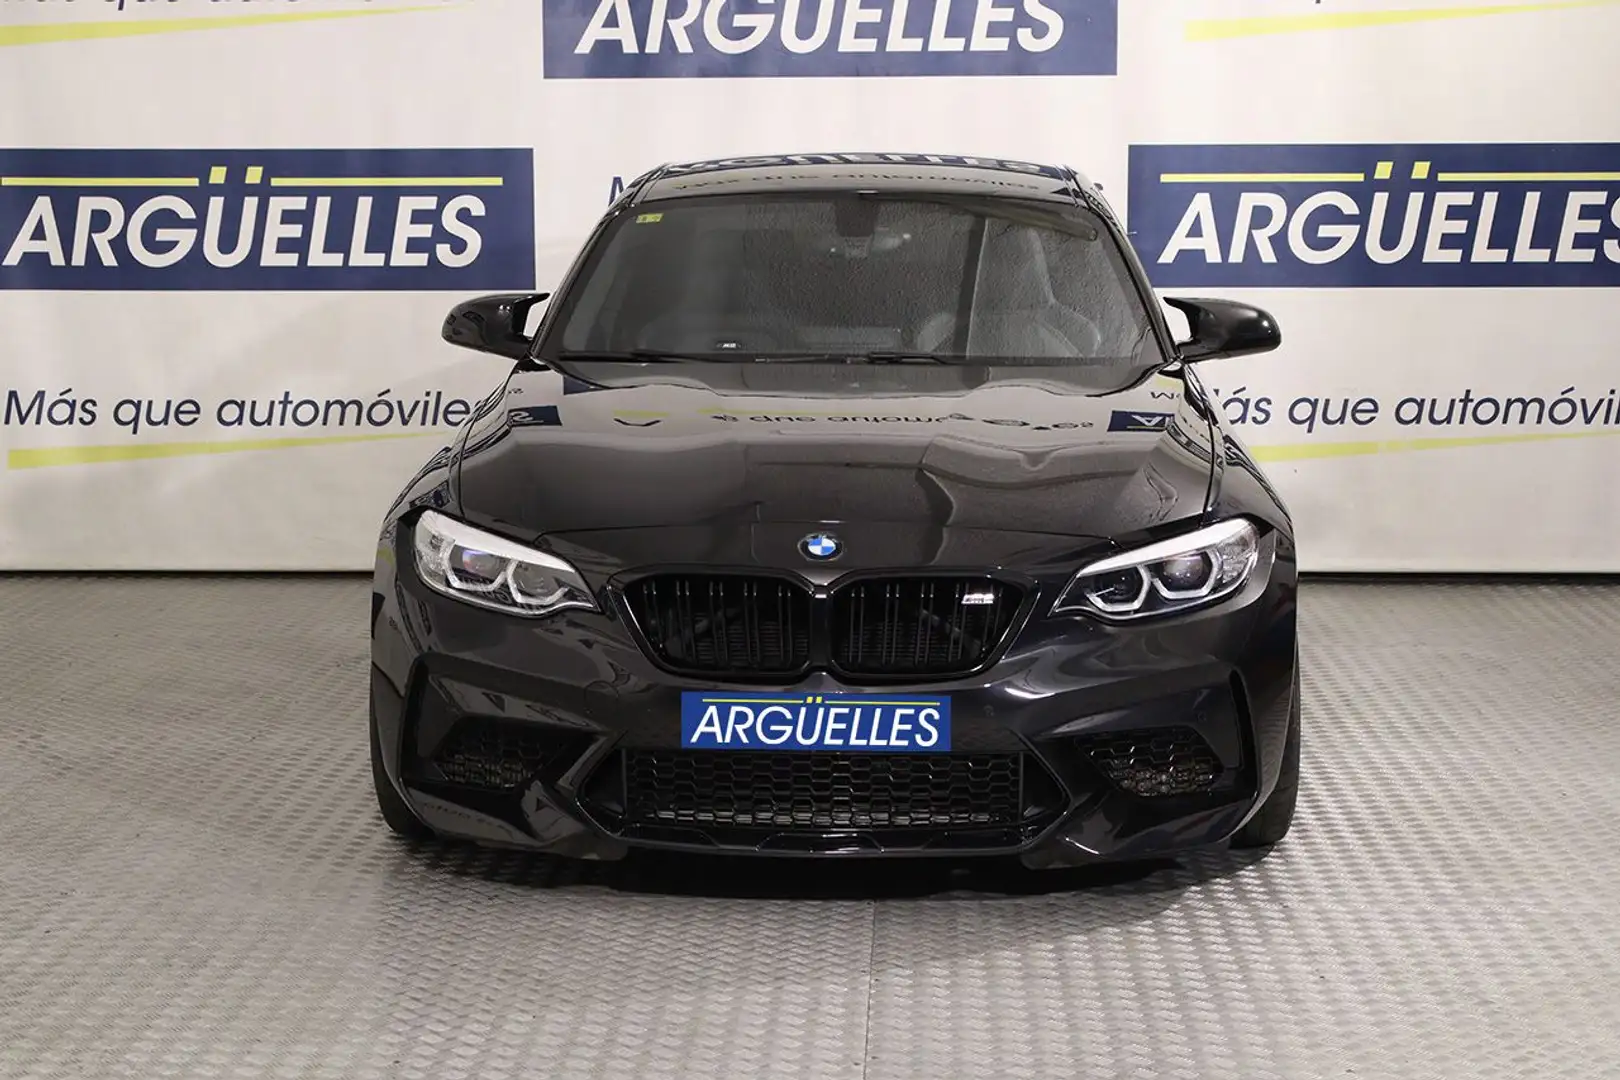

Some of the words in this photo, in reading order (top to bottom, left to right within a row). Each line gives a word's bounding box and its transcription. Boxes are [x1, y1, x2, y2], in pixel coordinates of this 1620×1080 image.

[2, 166, 485, 268] ARGÜELLES
[4, 388, 97, 426] Más
[113, 399, 200, 435] que
[216, 389, 484, 427] automóvile
[1288, 396, 1379, 434] que
[690, 696, 940, 747] ARGÜELLES
